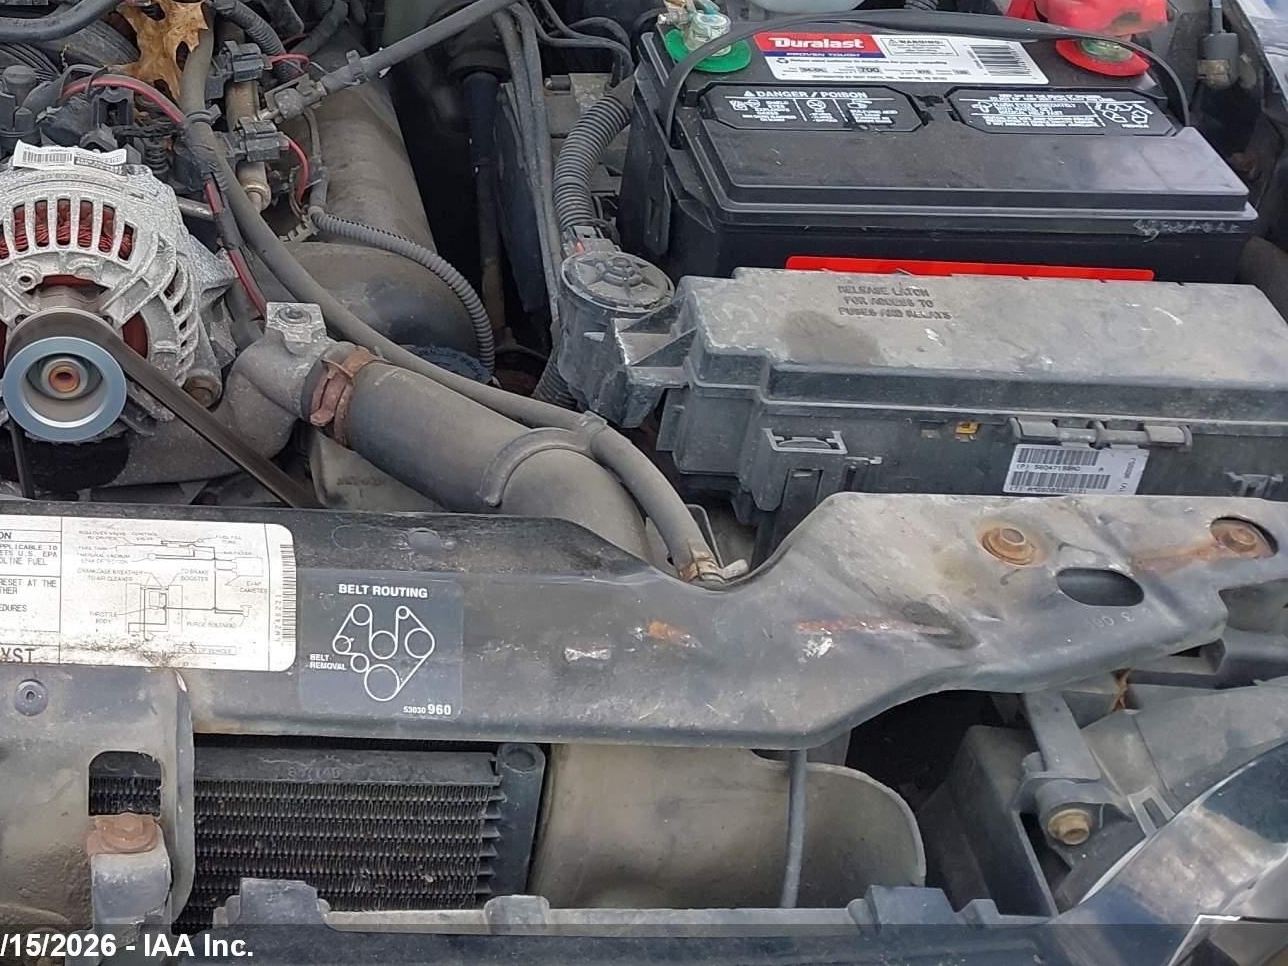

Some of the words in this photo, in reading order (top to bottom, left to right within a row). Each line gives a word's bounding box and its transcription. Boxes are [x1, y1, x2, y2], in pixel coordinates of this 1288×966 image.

[768, 37, 865, 48] Duralast
[755, 90, 808, 98] DANGER
[820, 91, 868, 99] POISON
[838, 285, 888, 295] RELEASE
[891, 286, 930, 297] LATCH
[844, 297, 868, 305] FOR
[871, 298, 915, 307] ACCESS
[918, 299, 934, 308] TO
[838, 307, 877, 316] FUSES
[880, 309, 904, 317] AND
[905, 310, 952, 320] RELAYS
[42, 550, 58, 558] EPA
[27, 557, 49, 566] FUEL
[27, 579, 38, 587] AT
[42, 579, 57, 588] THE
[338, 584, 370, 595] BELT
[372, 585, 428, 599] ROUTING
[309, 653, 330, 661] BELT
[309, 661, 347, 671] REMOVAL
